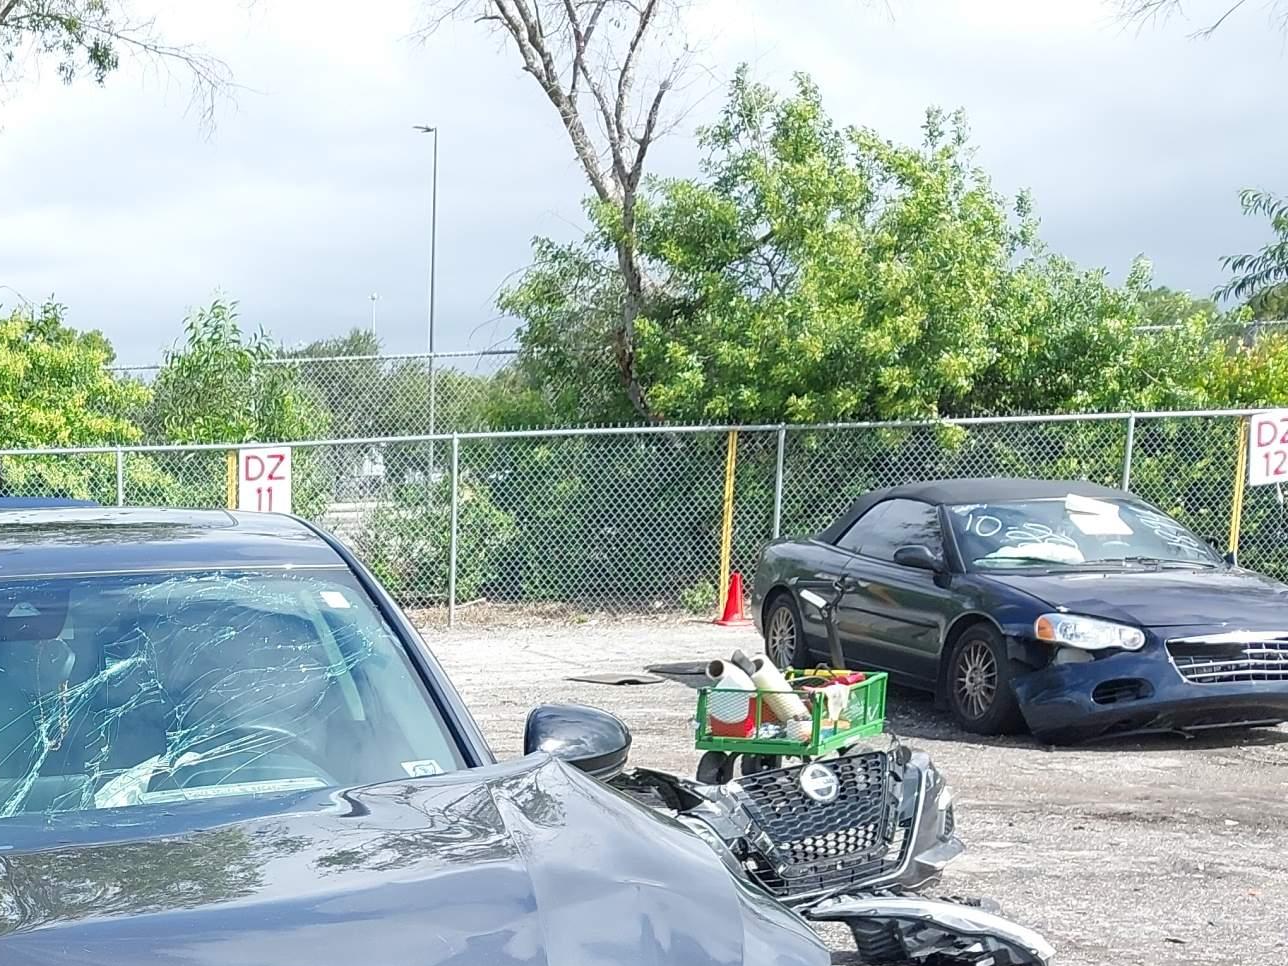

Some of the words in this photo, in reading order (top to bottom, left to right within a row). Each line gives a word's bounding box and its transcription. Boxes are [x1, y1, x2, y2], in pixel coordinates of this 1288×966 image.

[245, 454, 286, 481] DZ
[1263, 450, 1288, 477] 12
[256, 487, 273, 512] 11
